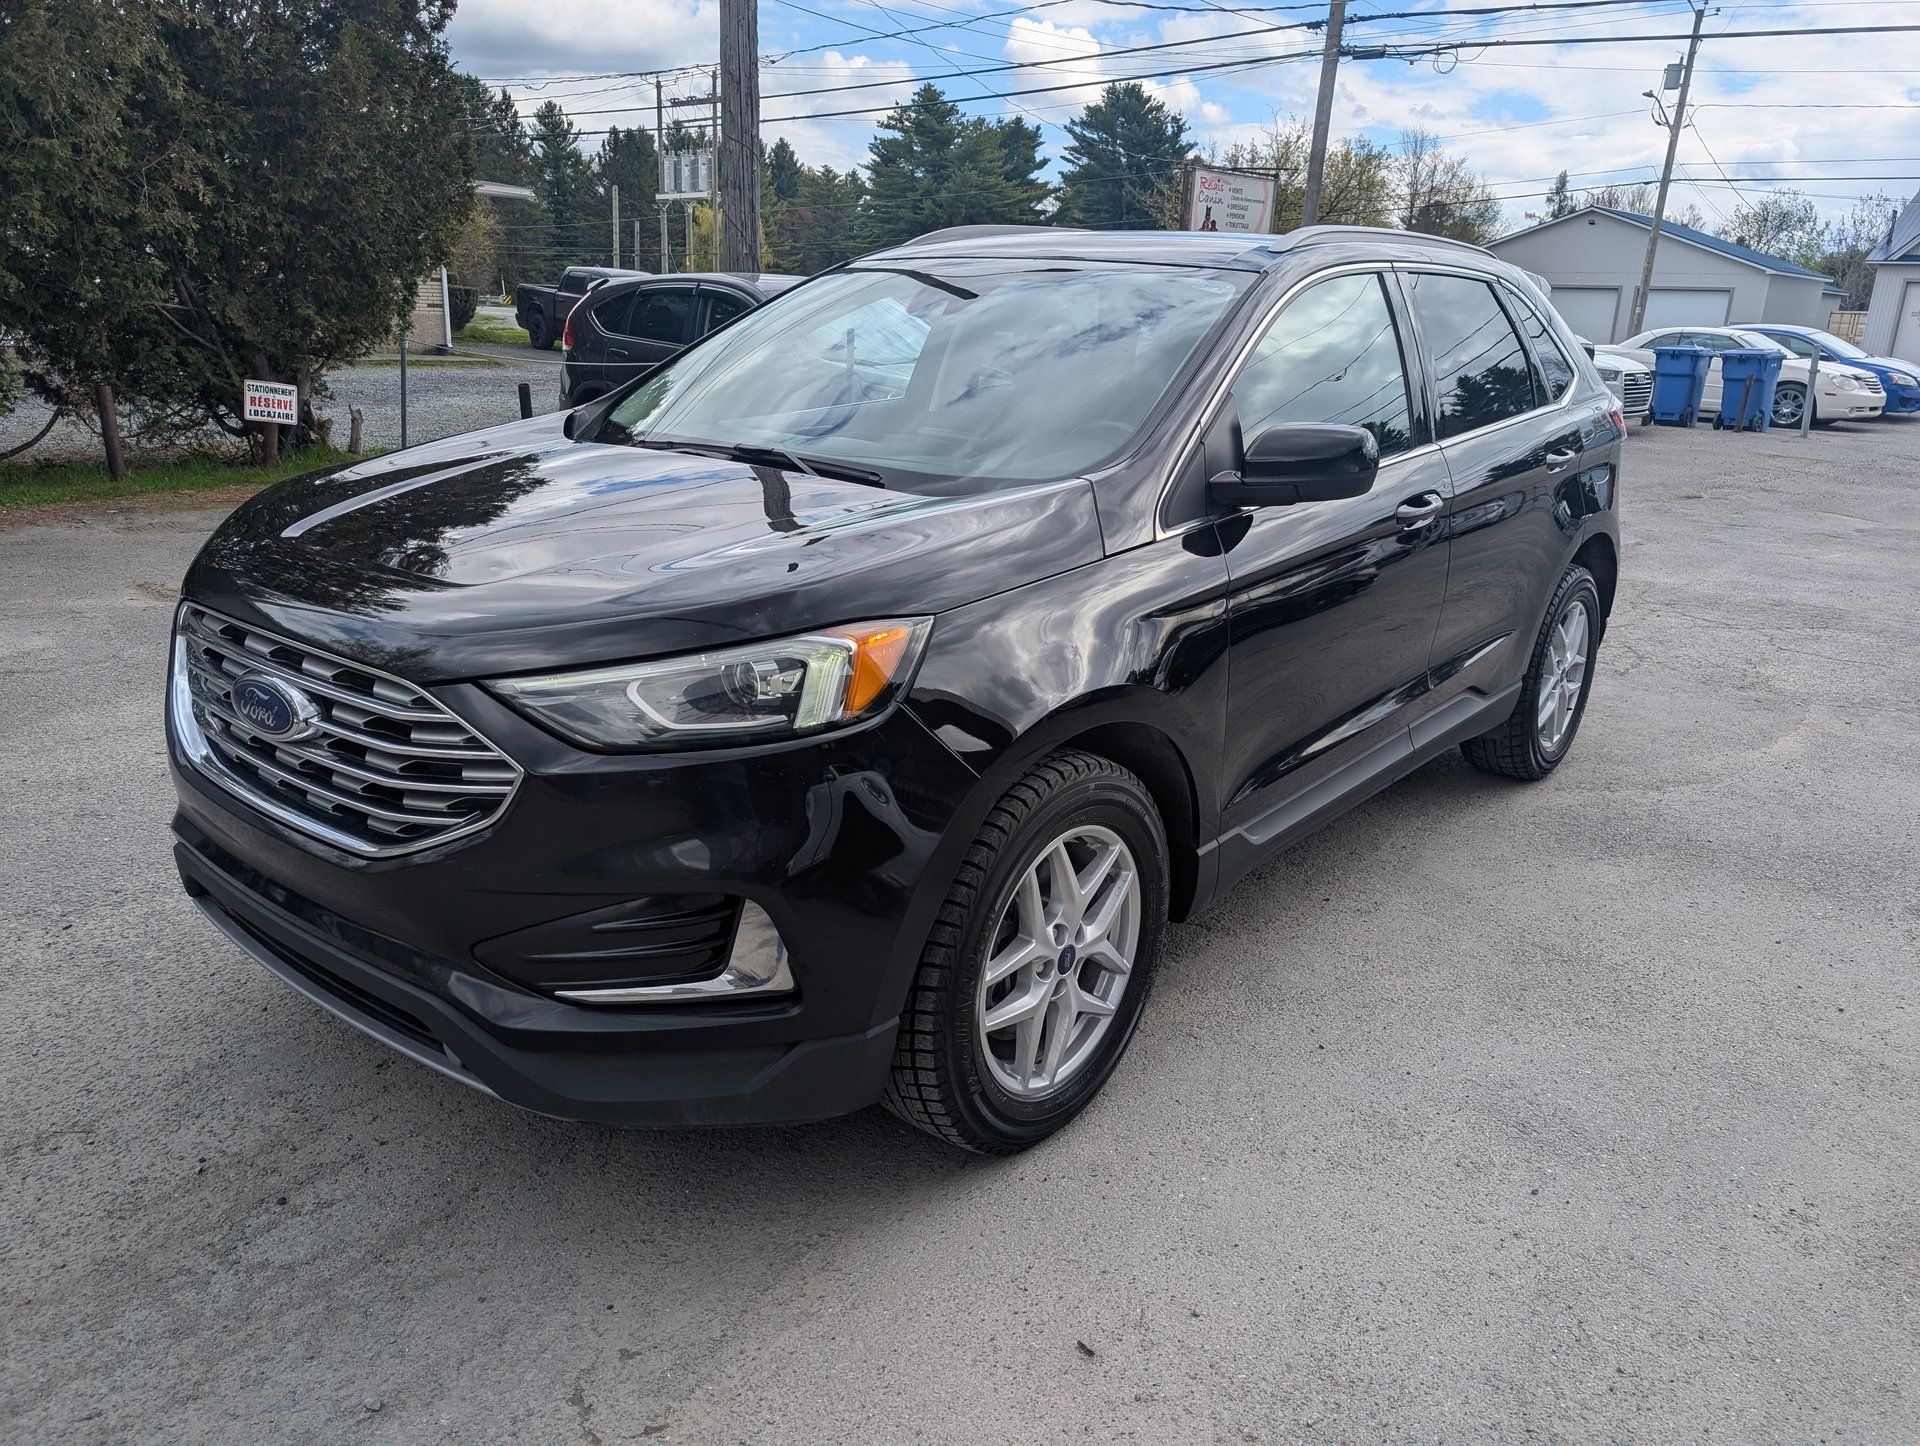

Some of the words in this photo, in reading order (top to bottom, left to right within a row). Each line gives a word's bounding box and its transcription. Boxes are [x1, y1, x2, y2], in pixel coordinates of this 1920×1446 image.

[1200, 176, 1224, 192] Relais
[1199, 190, 1225, 204] Canin
[247, 383, 295, 397] STATIONNEMENT
[248, 409, 294, 421] LOCATAIRE
[240, 687, 278, 727] Ford
